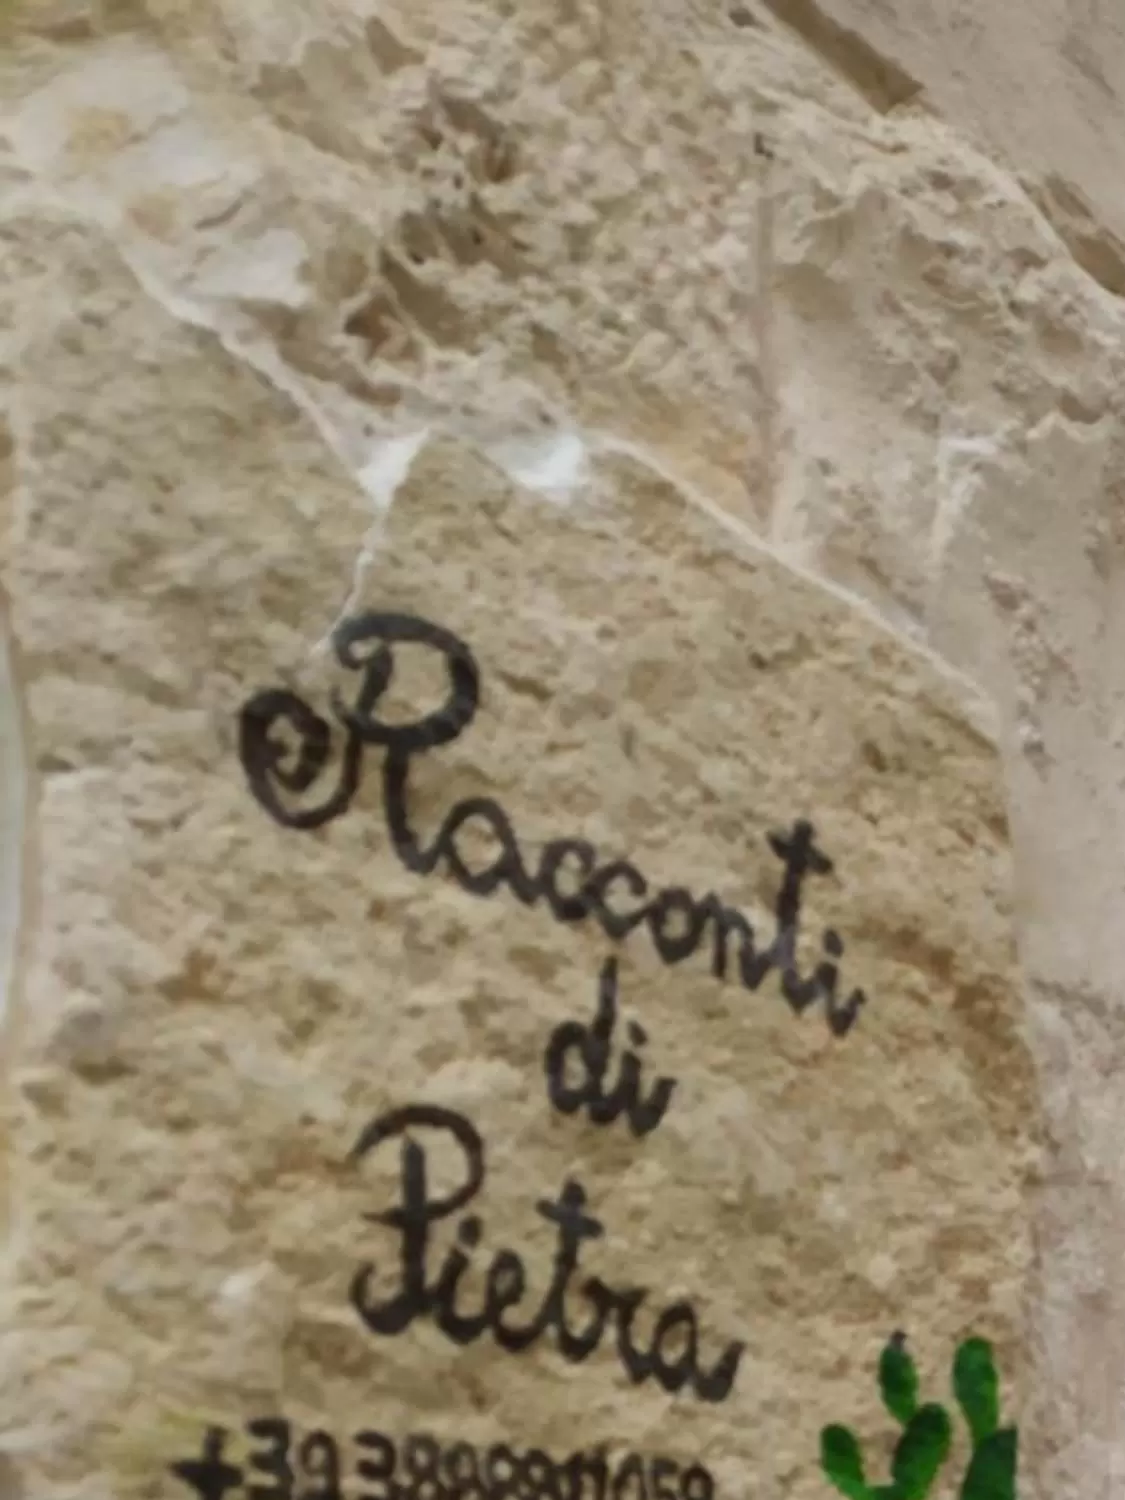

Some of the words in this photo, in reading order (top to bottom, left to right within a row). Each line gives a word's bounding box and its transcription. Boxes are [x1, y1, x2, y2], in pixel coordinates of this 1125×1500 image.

[239, 612, 866, 1037] Racconti
[544, 956, 676, 1137] di
[350, 1104, 746, 1402] Pietra
